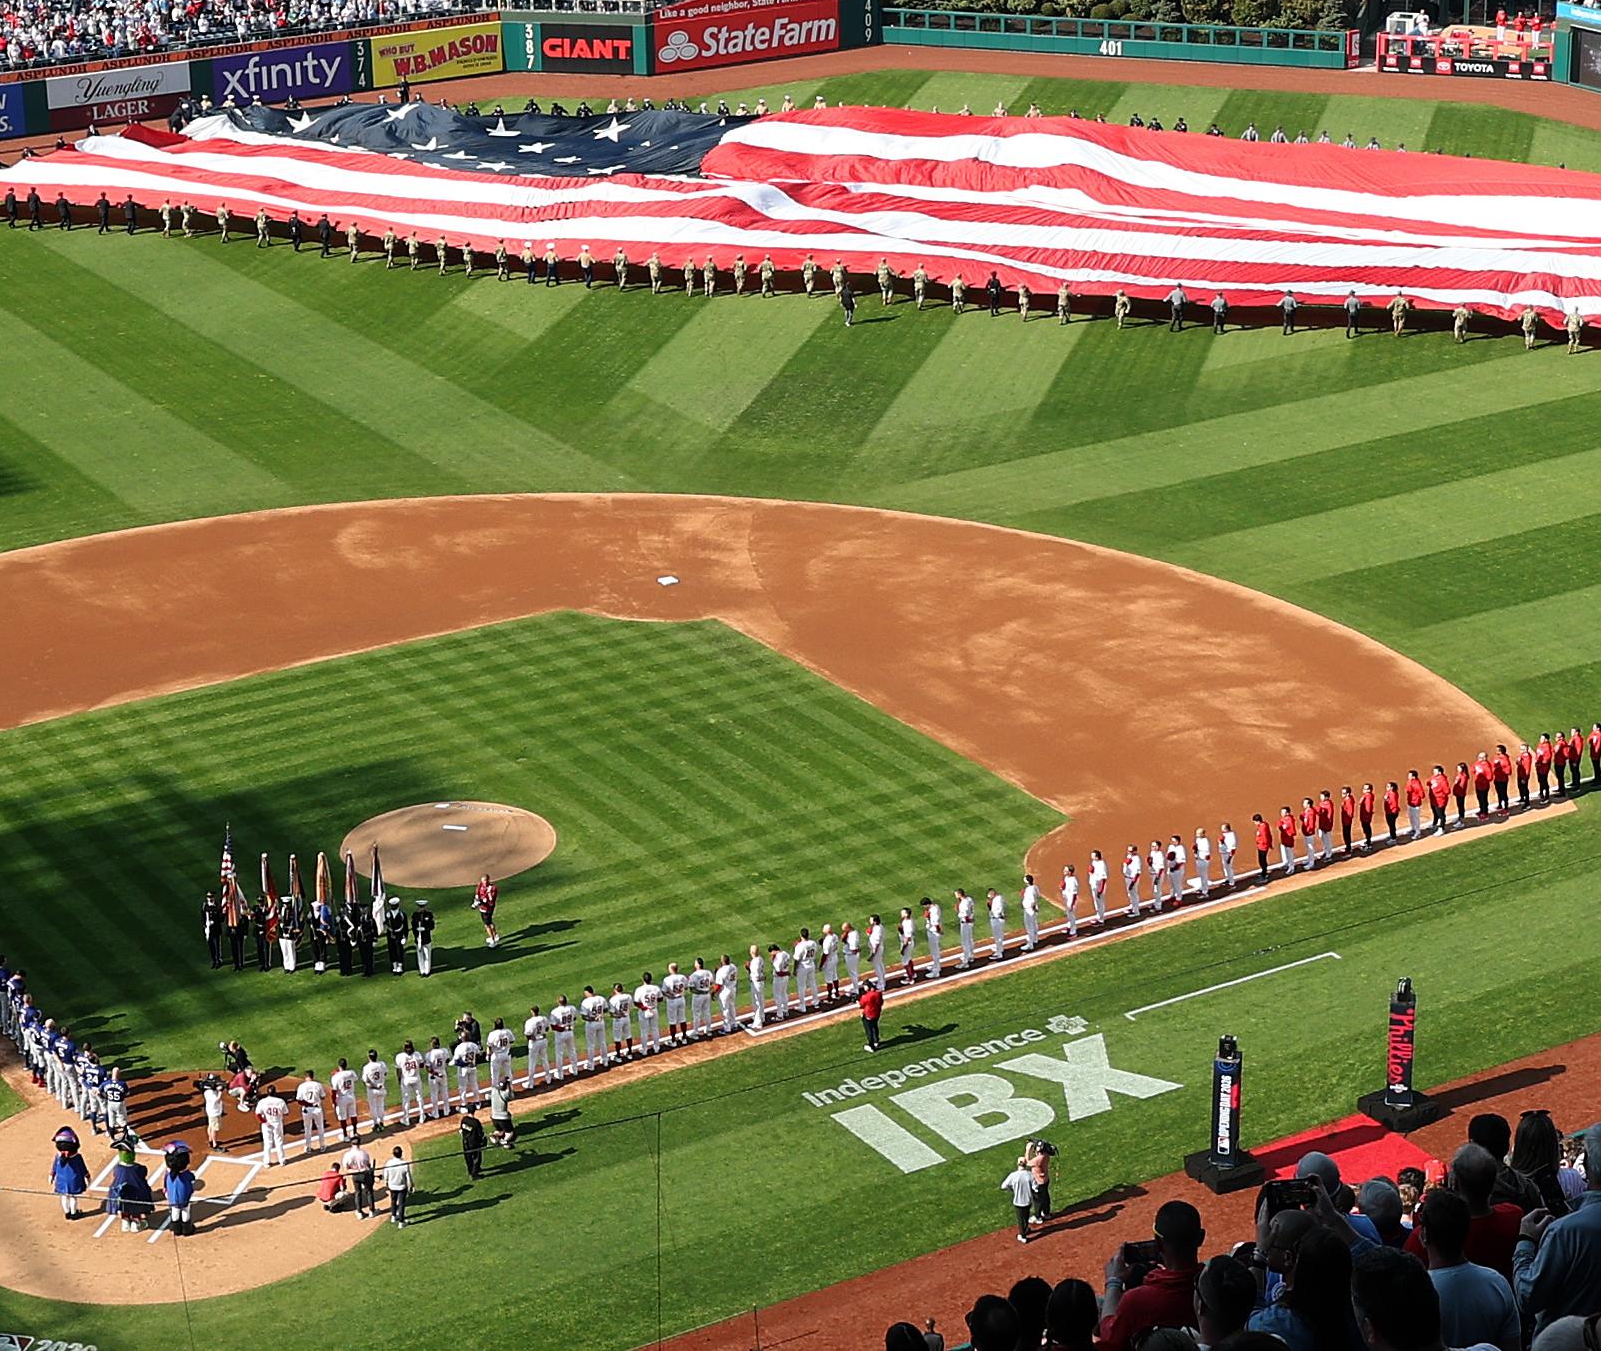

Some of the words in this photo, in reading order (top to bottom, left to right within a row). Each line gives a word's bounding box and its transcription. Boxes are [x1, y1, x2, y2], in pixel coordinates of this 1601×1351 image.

[659, 7, 678, 19] Like
[688, 4, 709, 18] good
[710, 0, 750, 14] neighbor,
[184, 42, 255, 60] ASPLUNDH
[525, 22, 535, 70] 387
[542, 37, 632, 61] GIANT
[1099, 39, 1123, 56] 401
[16, 63, 88, 82] ASPLUNDH
[101, 52, 171, 71] ASPLUNDH
[356, 41, 366, 88] 374
[1454, 62, 1495, 74] TOYOTA
[74, 71, 164, 100] Yuengling
[222, 51, 345, 101] xfinity
[91, 97, 150, 121] LAGER
[1387, 1007, 1416, 1084] Phillies
[86, 1073, 99, 1084] 24
[801, 1025, 1044, 1109] Independence
[106, 1090, 121, 1102] 55
[830, 1033, 1185, 1175] IBX
